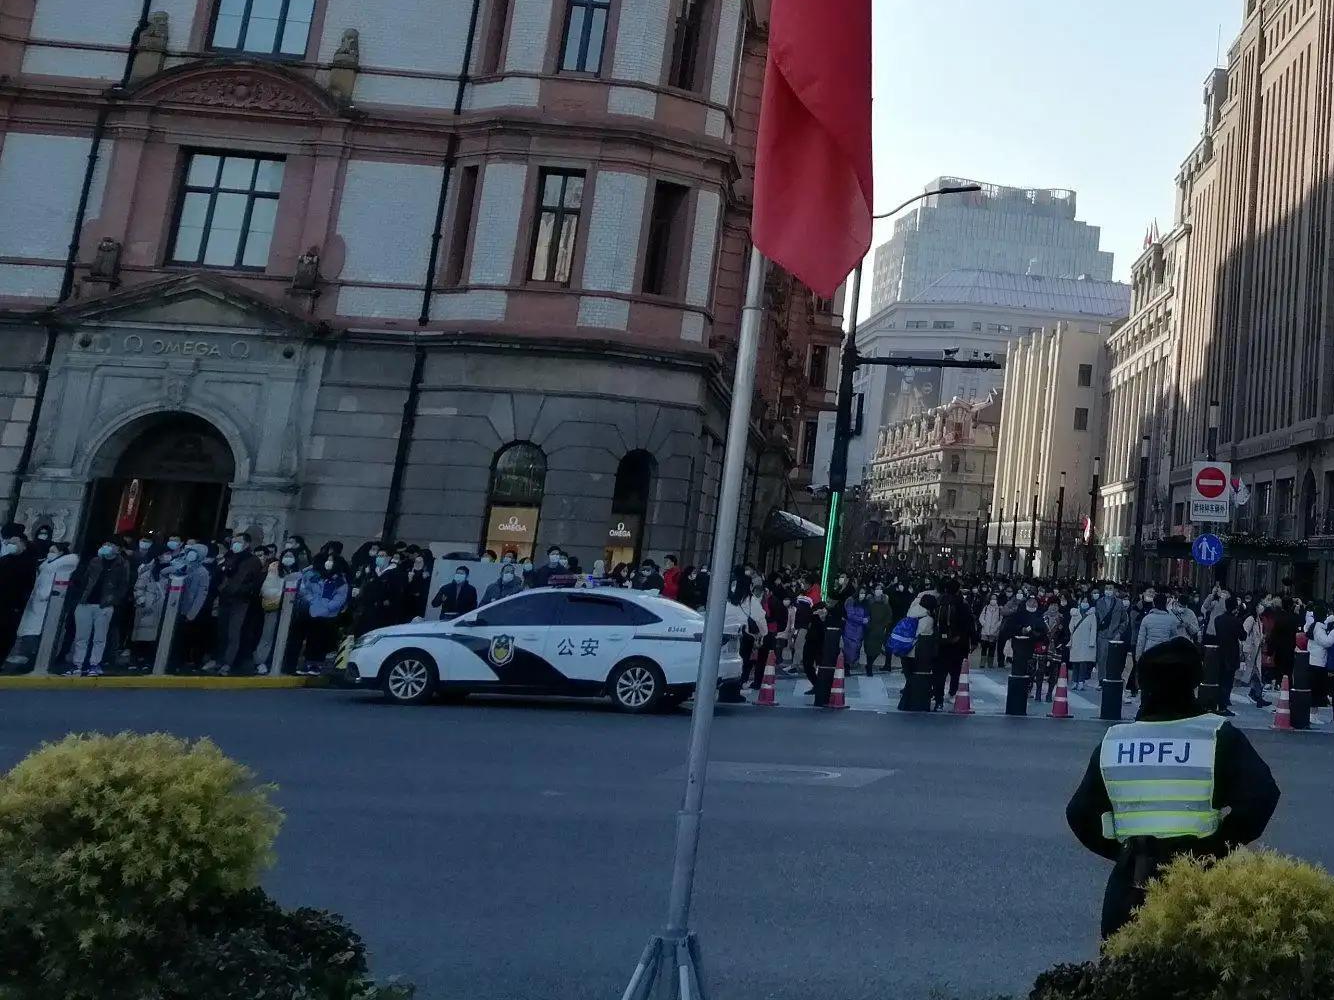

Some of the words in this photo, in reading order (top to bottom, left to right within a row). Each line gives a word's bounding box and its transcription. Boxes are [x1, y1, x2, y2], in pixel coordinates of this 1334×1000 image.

[151, 339, 223, 356] OMEGA
[498, 523, 527, 532] OMEGA
[609, 529, 632, 538] OMEGA
[557, 638, 600, 657] 公安
[1117, 742, 1191, 764] HPFJ
